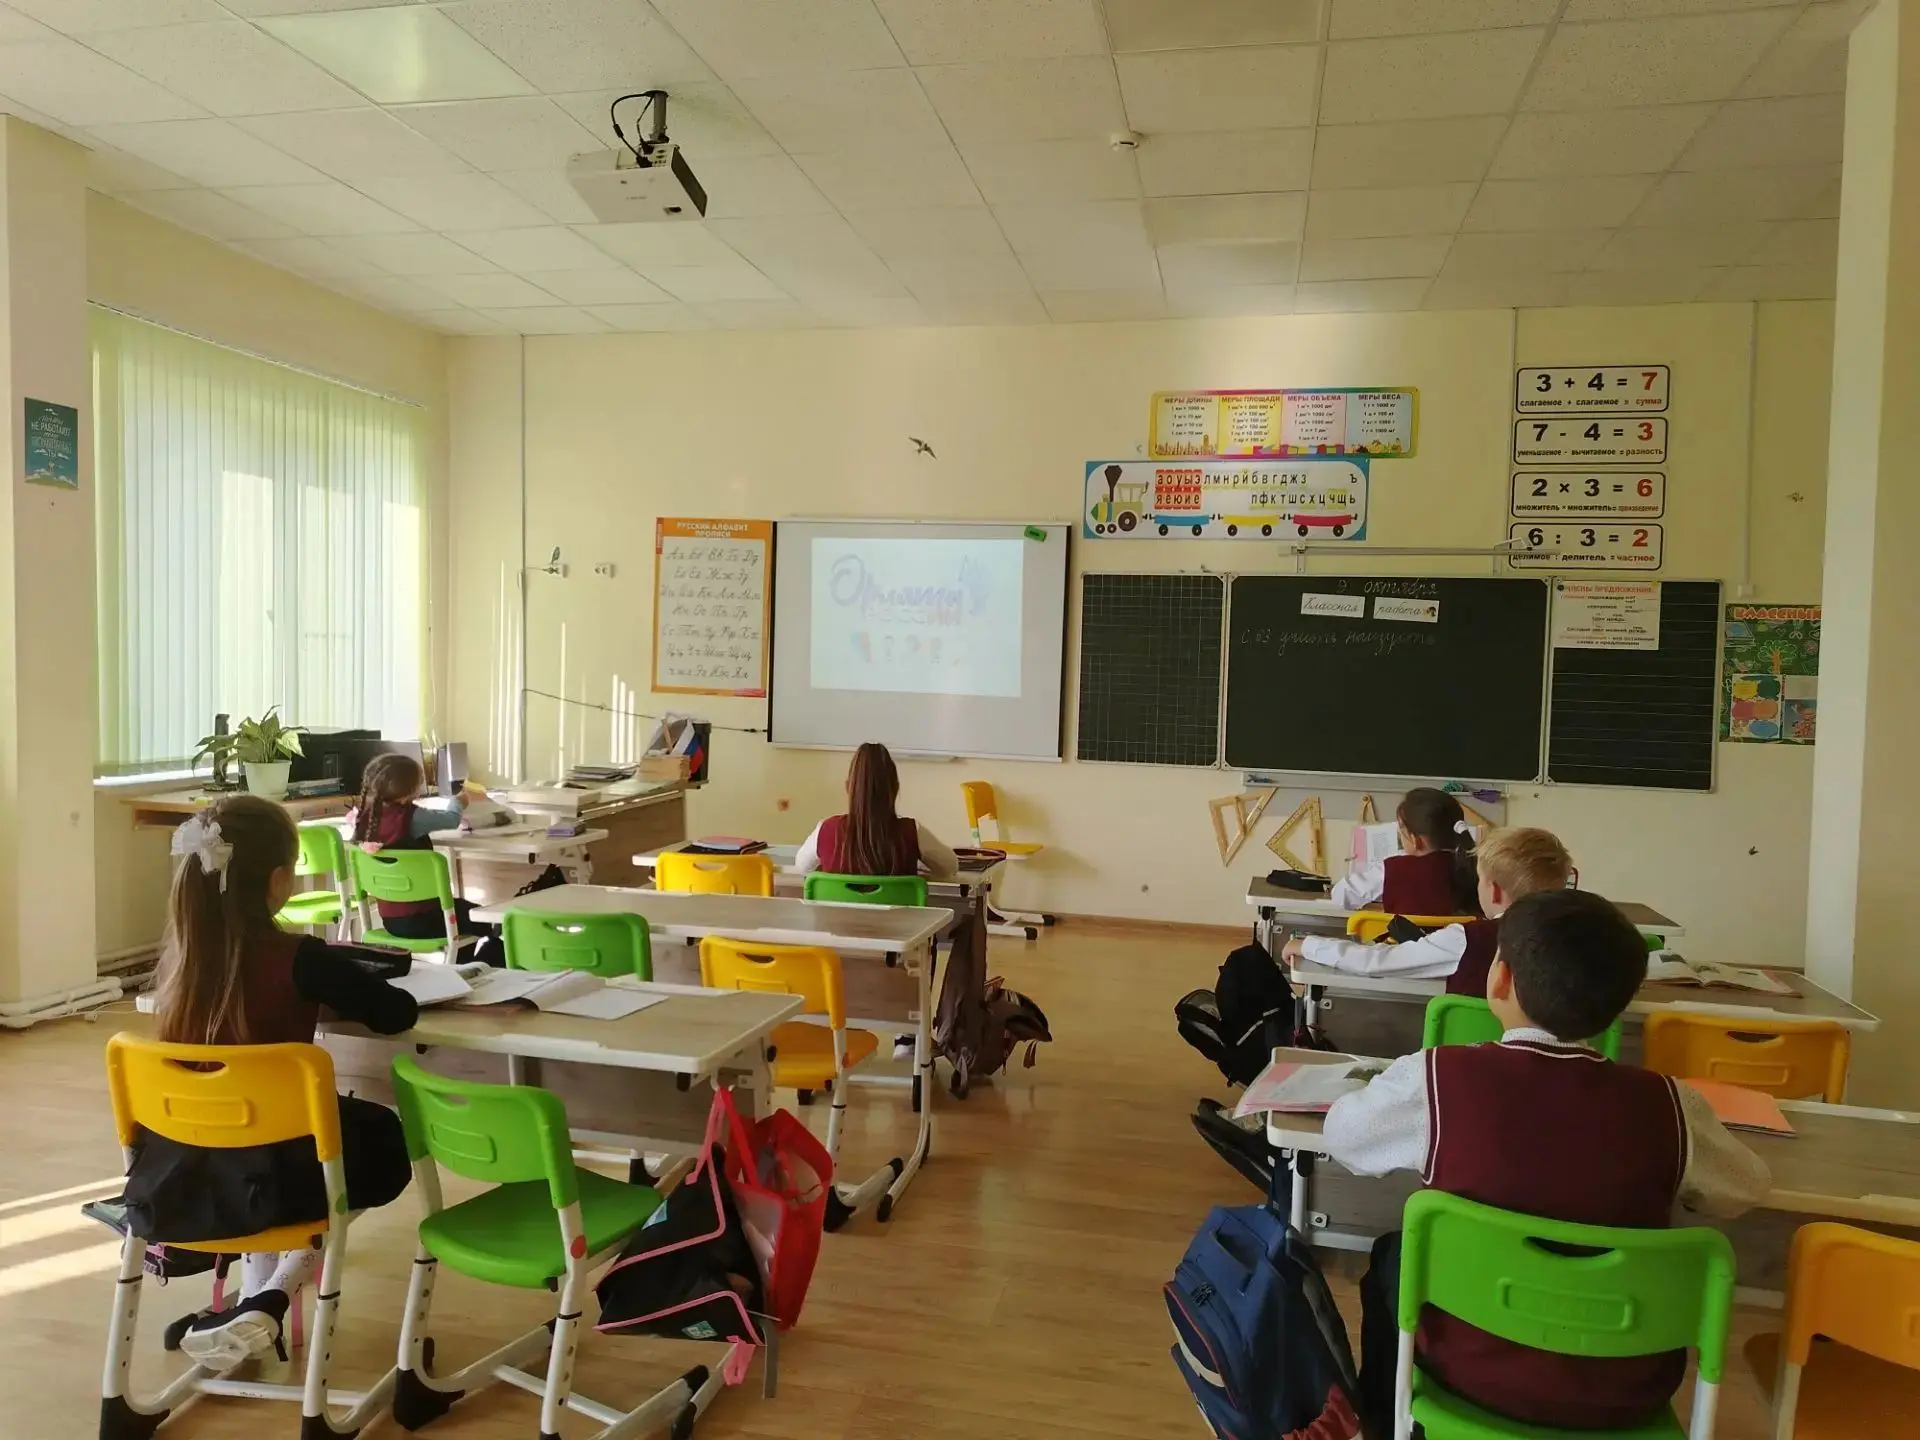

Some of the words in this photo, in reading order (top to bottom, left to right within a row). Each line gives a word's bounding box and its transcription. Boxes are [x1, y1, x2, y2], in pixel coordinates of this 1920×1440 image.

[1536, 374, 1551, 392] 3
[1588, 372, 1604, 391] 4
[1642, 372, 1658, 391] 7
[1635, 398, 1662, 407] сумма
[1533, 424, 1548, 442] 7
[1584, 422, 1600, 441] 4
[1637, 422, 1653, 441] 3
[1517, 449, 1561, 457] уменьшаемое
[1532, 478, 1548, 497] 2
[1584, 478, 1600, 497] 3
[1637, 478, 1653, 497] 6
[1528, 528, 1544, 546] 6
[1580, 528, 1596, 547] 3
[1632, 529, 1648, 547] 2
[1304, 597, 1358, 612] Классная
[1375, 601, 1421, 617] работа
